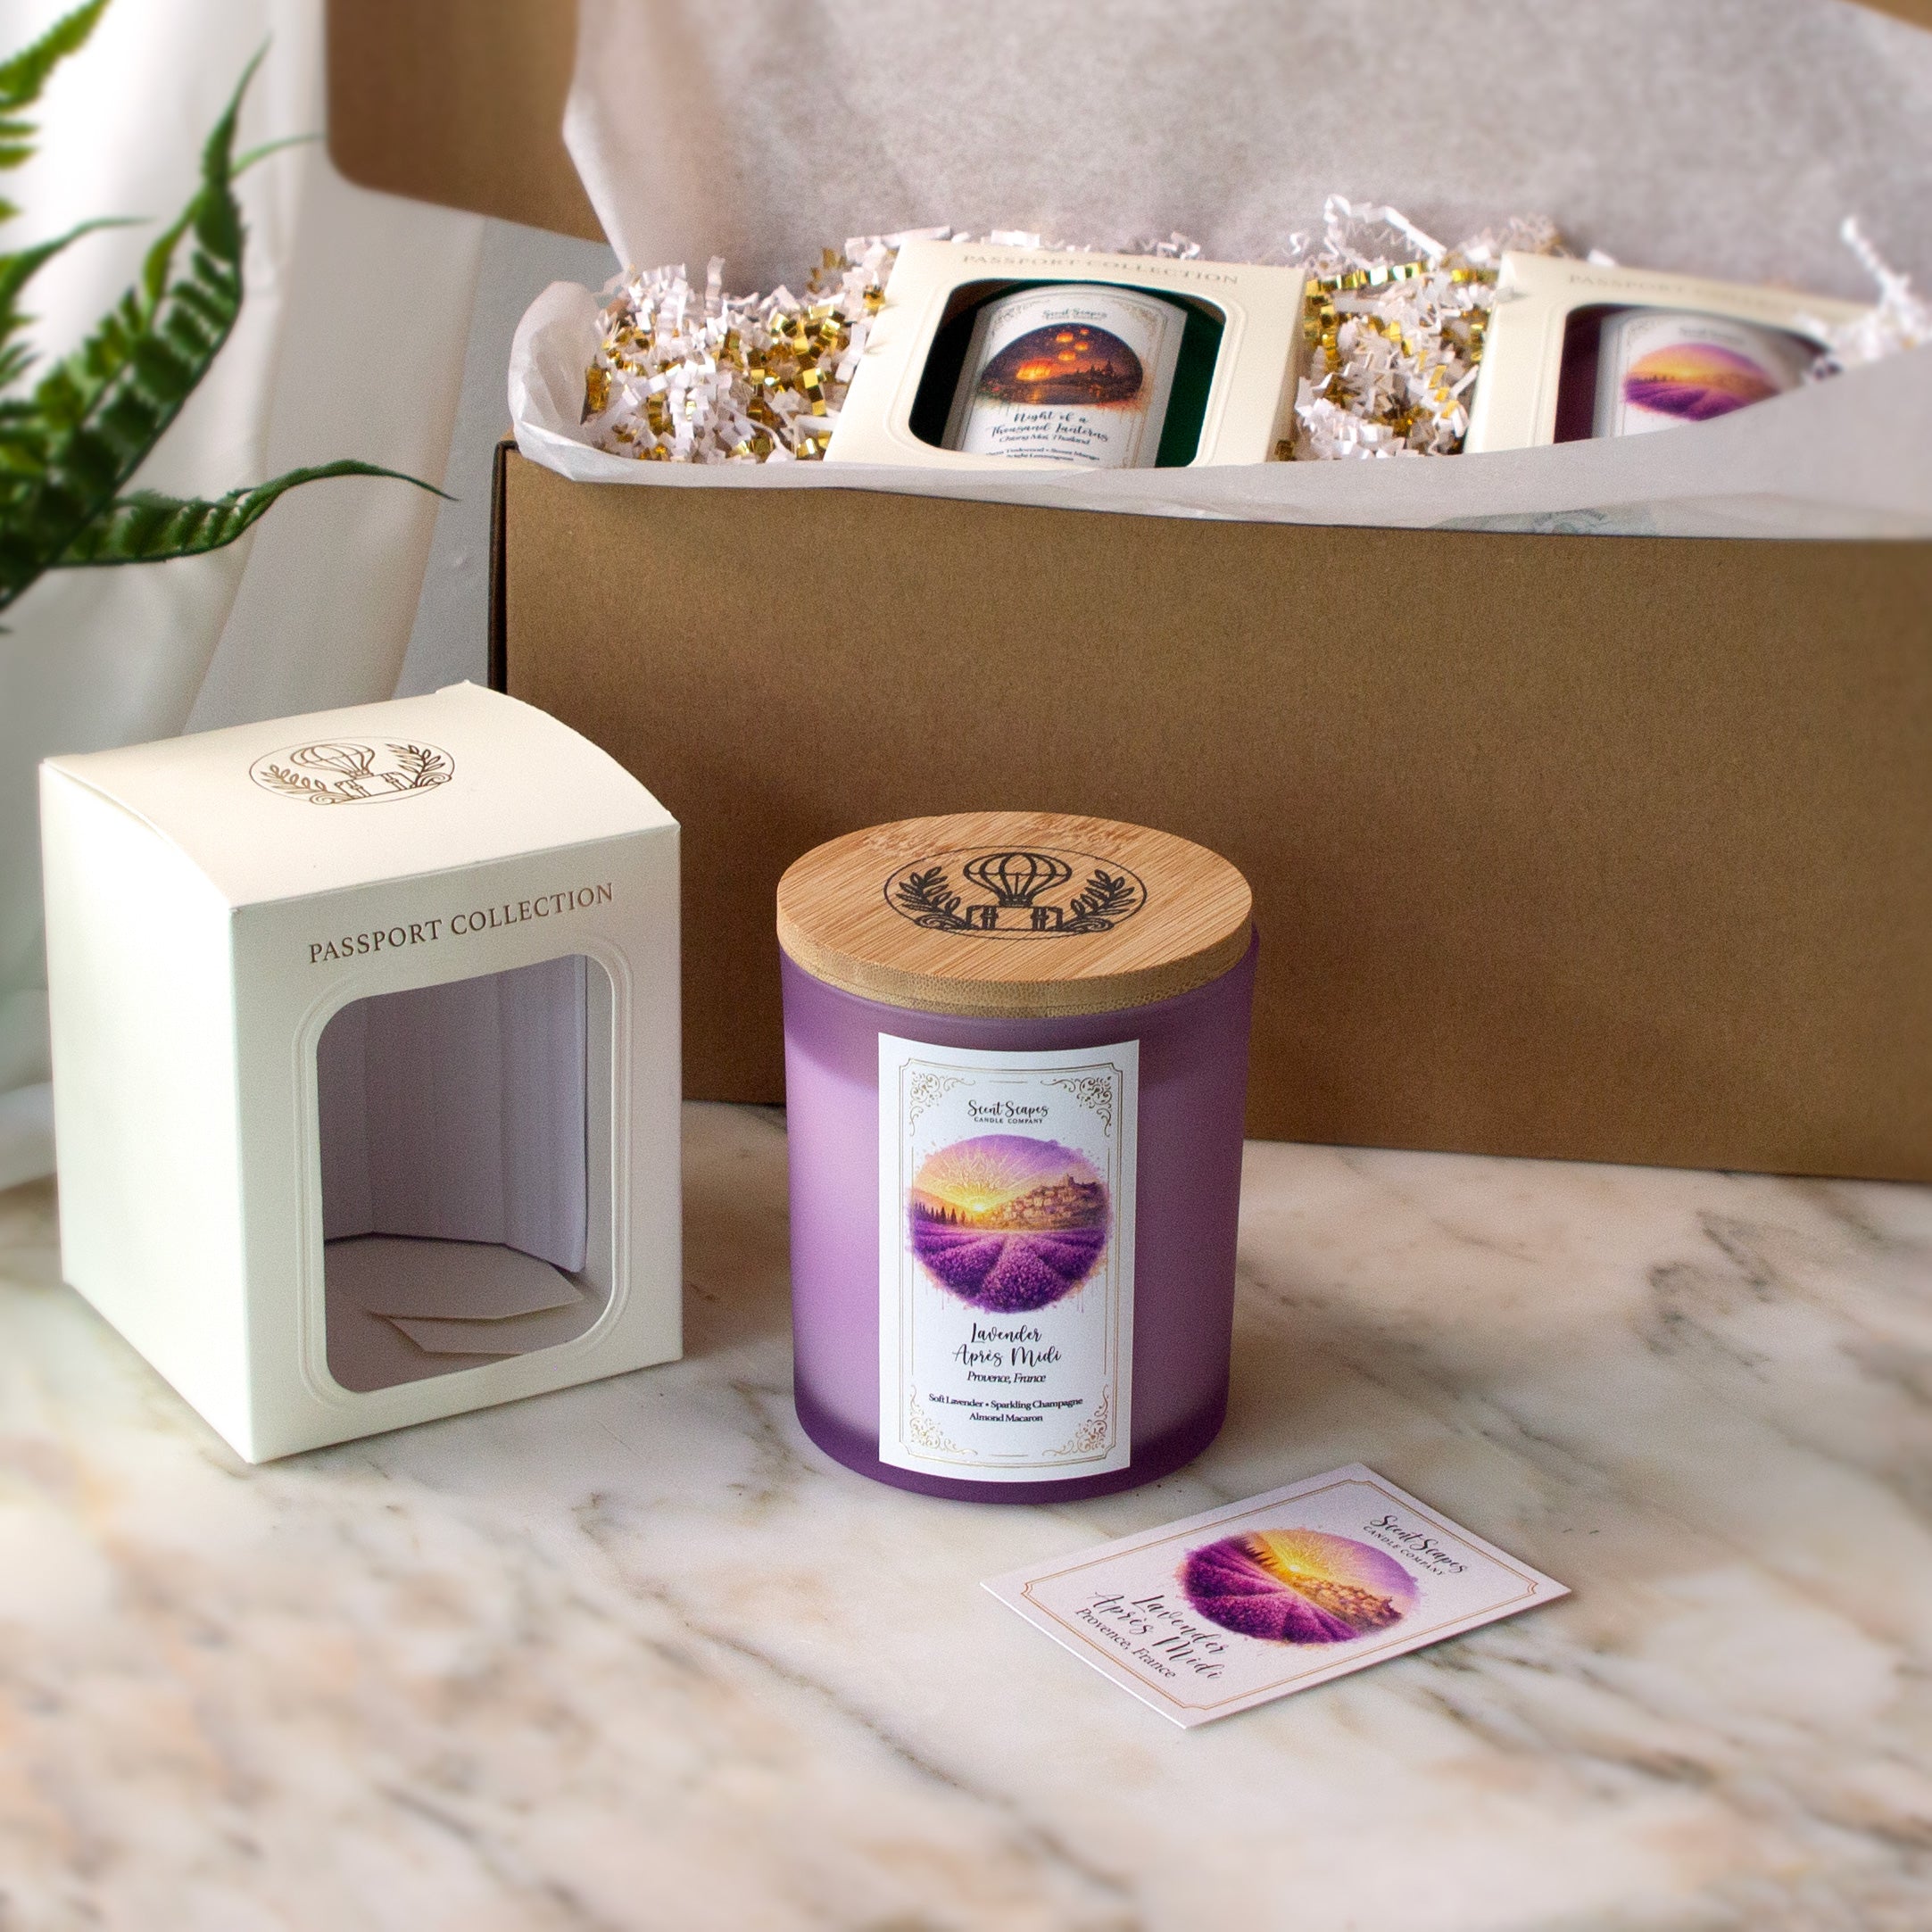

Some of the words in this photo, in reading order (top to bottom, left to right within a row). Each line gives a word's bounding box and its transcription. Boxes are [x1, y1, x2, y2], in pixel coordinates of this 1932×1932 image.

[962, 254, 1077, 267] PASSPORT
[1086, 260, 1240, 285] COLLECTION
[309, 917, 443, 964] PASSPORT
[450, 883, 614, 935] COLLECTION
[974, 1116, 1004, 1124] CANDLE
[1007, 1117, 1044, 1125] COMPANY
[970, 1322, 1043, 1344] Lavender
[951, 1343, 1004, 1367] Après
[1011, 1345, 1062, 1368] Midi
[966, 1371, 1012, 1384] Provence,
[1013, 1372, 1047, 1384] France
[928, 1393, 945, 1405] Soft
[945, 1396, 984, 1408] Lavender
[990, 1399, 1032, 1411] Sparkling
[1032, 1397, 1083, 1410] Champagne
[969, 1412, 1005, 1422] Almond
[1005, 1414, 1043, 1422] Macaron
[1363, 1525, 1402, 1550] CANDLE
[1400, 1548, 1447, 1577] COMPANY
[1086, 1591, 1155, 1635] Après
[1151, 1636, 1225, 1679] Midi
[1130, 1594, 1230, 1655] Lavender
[1074, 1607, 1132, 1651] Provence,
[1132, 1646, 1177, 1679] France
